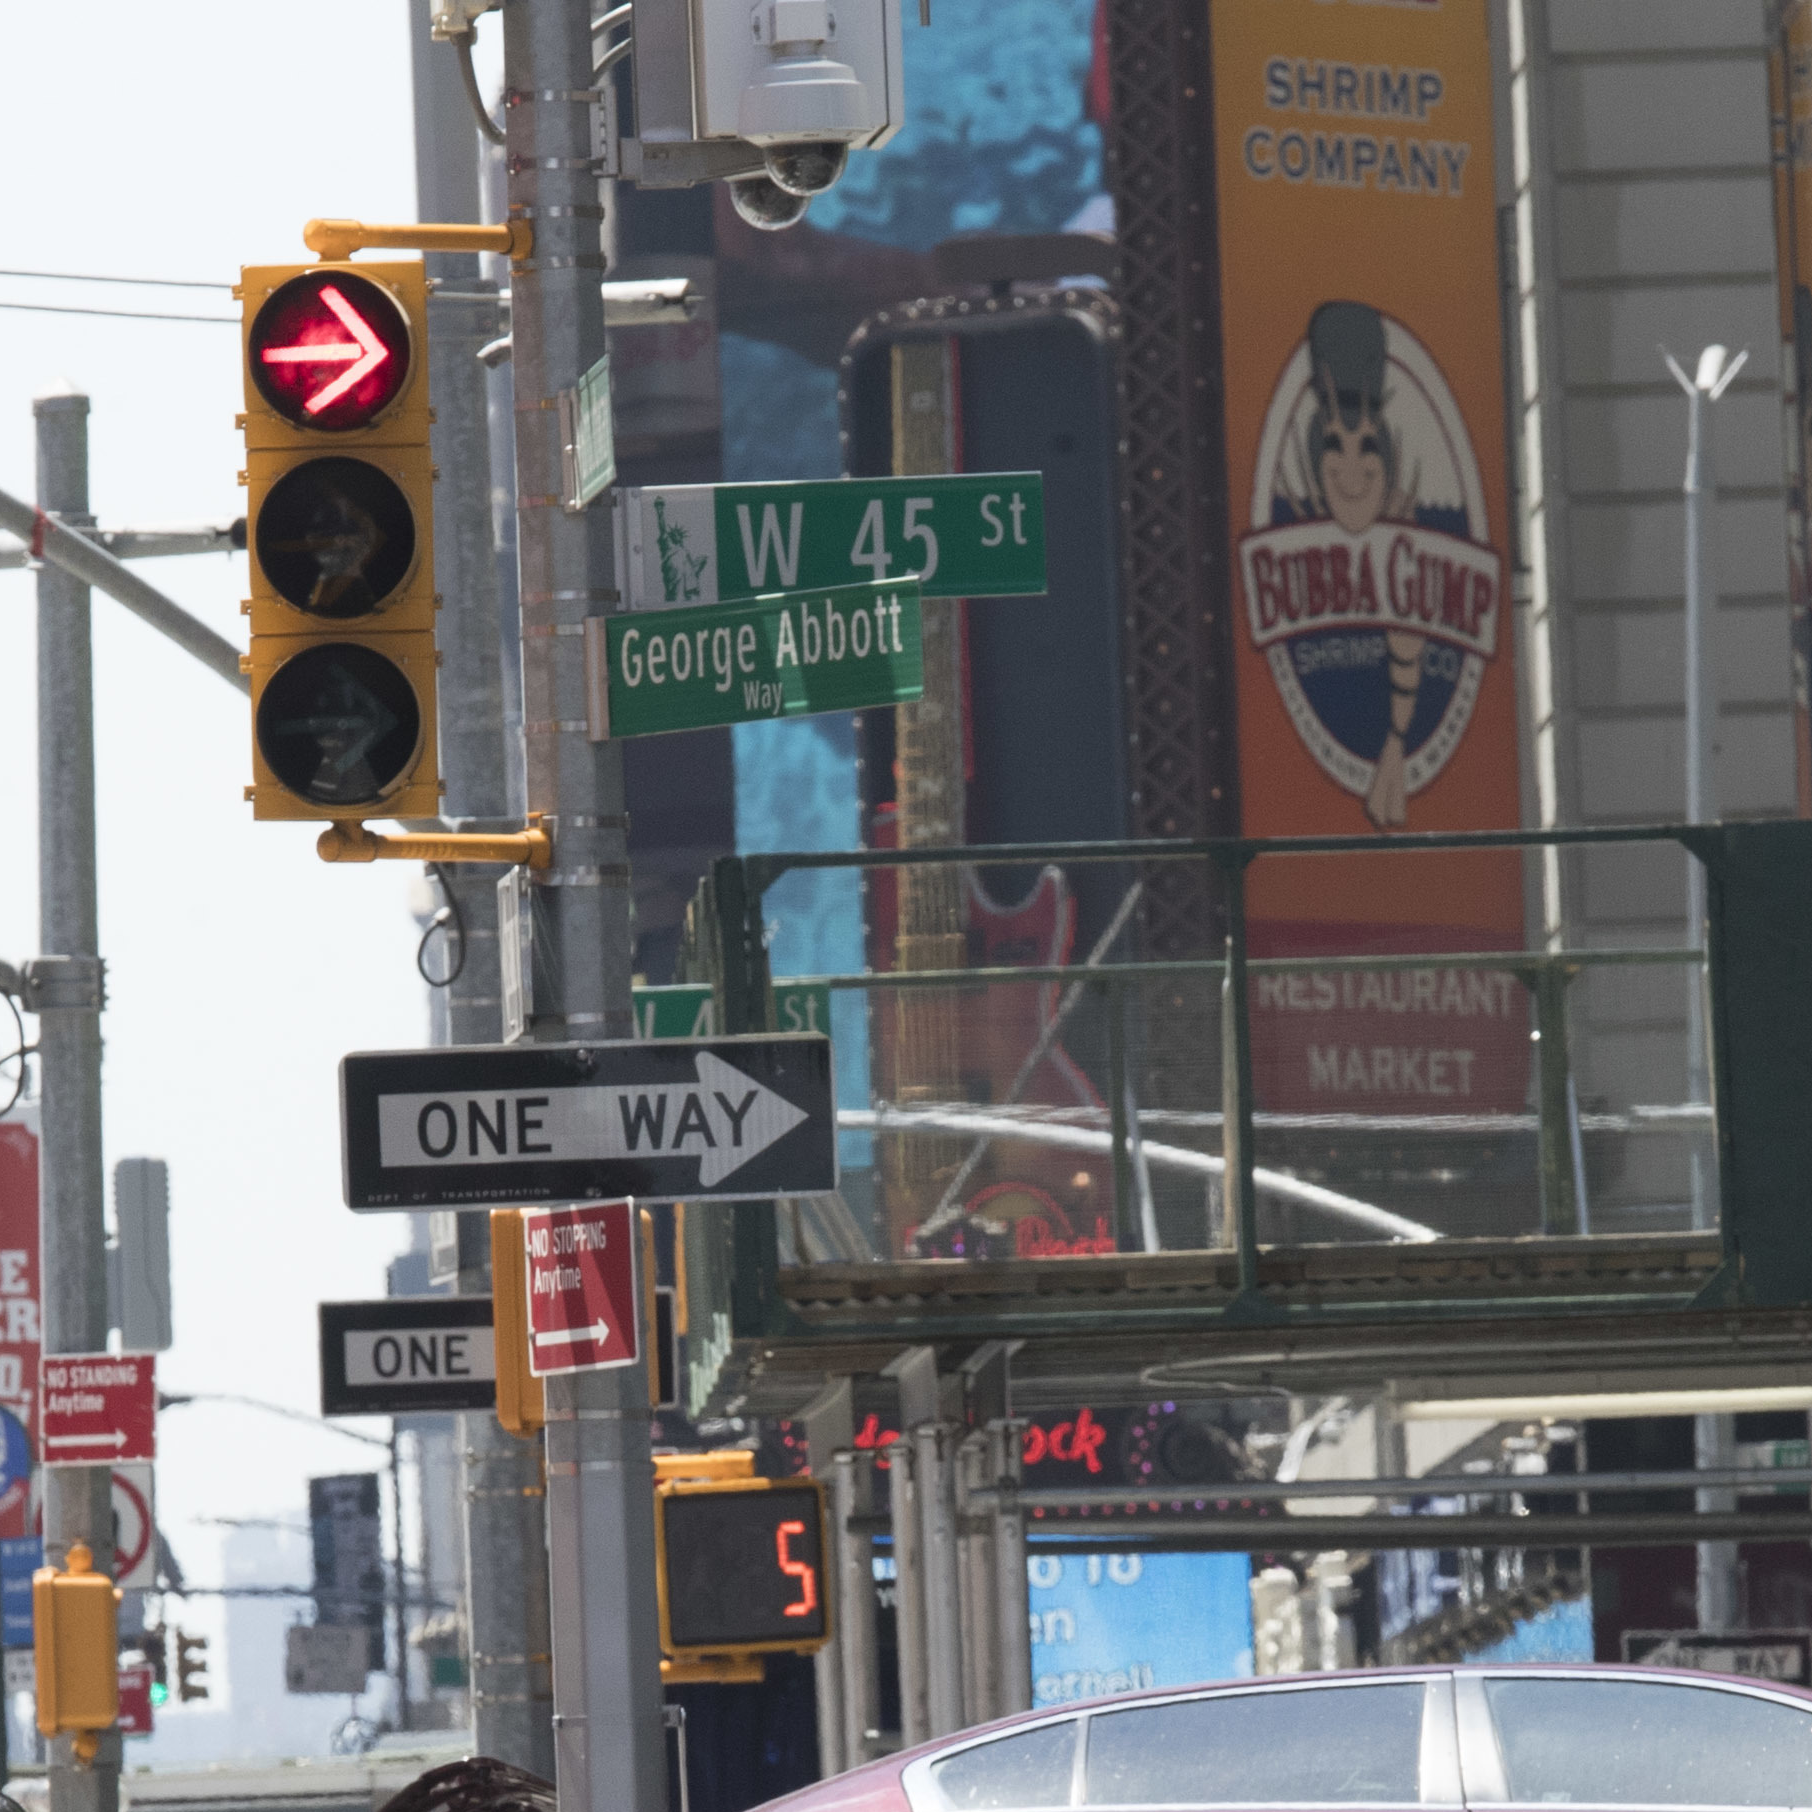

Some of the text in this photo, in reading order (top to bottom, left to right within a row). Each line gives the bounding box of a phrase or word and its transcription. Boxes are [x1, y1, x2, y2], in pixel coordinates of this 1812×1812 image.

[1266, 57, 1443, 121] SHRIMP
[1244, 128, 1469, 196] COMPANY
[736, 492, 1027, 588] W 45 St
[1251, 533, 1492, 638] BUBBA GUMP
[621, 593, 903, 692] George Abbott
[743, 681, 783, 715] Way
[785, 993, 819, 1032] St
[1258, 970, 1517, 1017] RESTAURANT
[1307, 1045, 1475, 1097] MARKET
[417, 1089, 759, 1159] ONE WAY
[368, 1187, 551, 1203] DEPT OF TRANSPORTATION
[531, 1220, 607, 1258] NO STOPPING
[534, 1264, 582, 1300] Anytime
[48, 1364, 138, 1388] NO STANDING
[373, 1333, 470, 1378] ONE
[48, 1392, 105, 1416] Anytime
[1022, 1407, 1107, 1474] ock
[776, 1521, 817, 1617] 5
